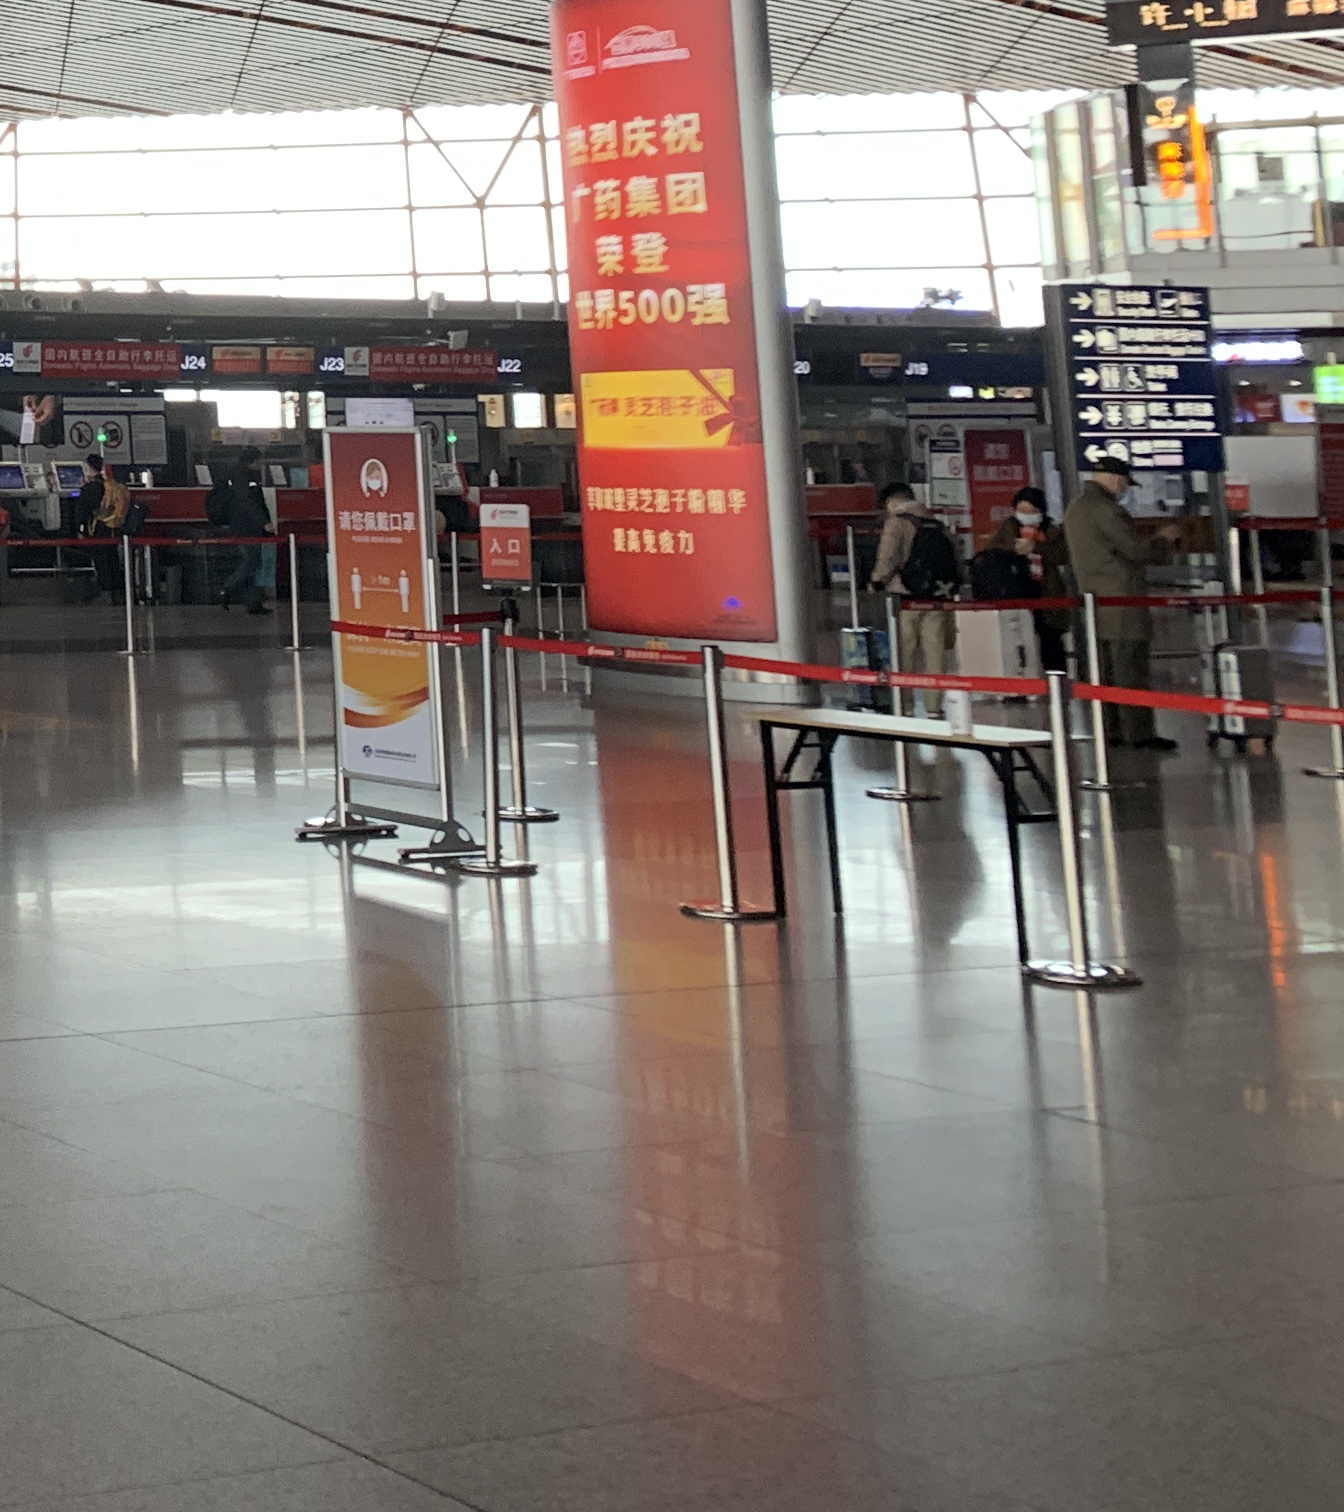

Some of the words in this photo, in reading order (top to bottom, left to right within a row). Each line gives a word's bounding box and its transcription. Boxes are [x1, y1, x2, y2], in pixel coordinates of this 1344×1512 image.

[594, 232, 670, 277] 荣登
[574, 283, 731, 330] 世界500强
[180, 355, 207, 370] J24
[319, 357, 344, 371] J23
[497, 359, 522, 373] J22
[793, 360, 811, 374] 20
[338, 510, 417, 532] 请您佩戴口罩
[489, 537, 521, 554] 入口
[613, 527, 695, 555] 提高免疫力
